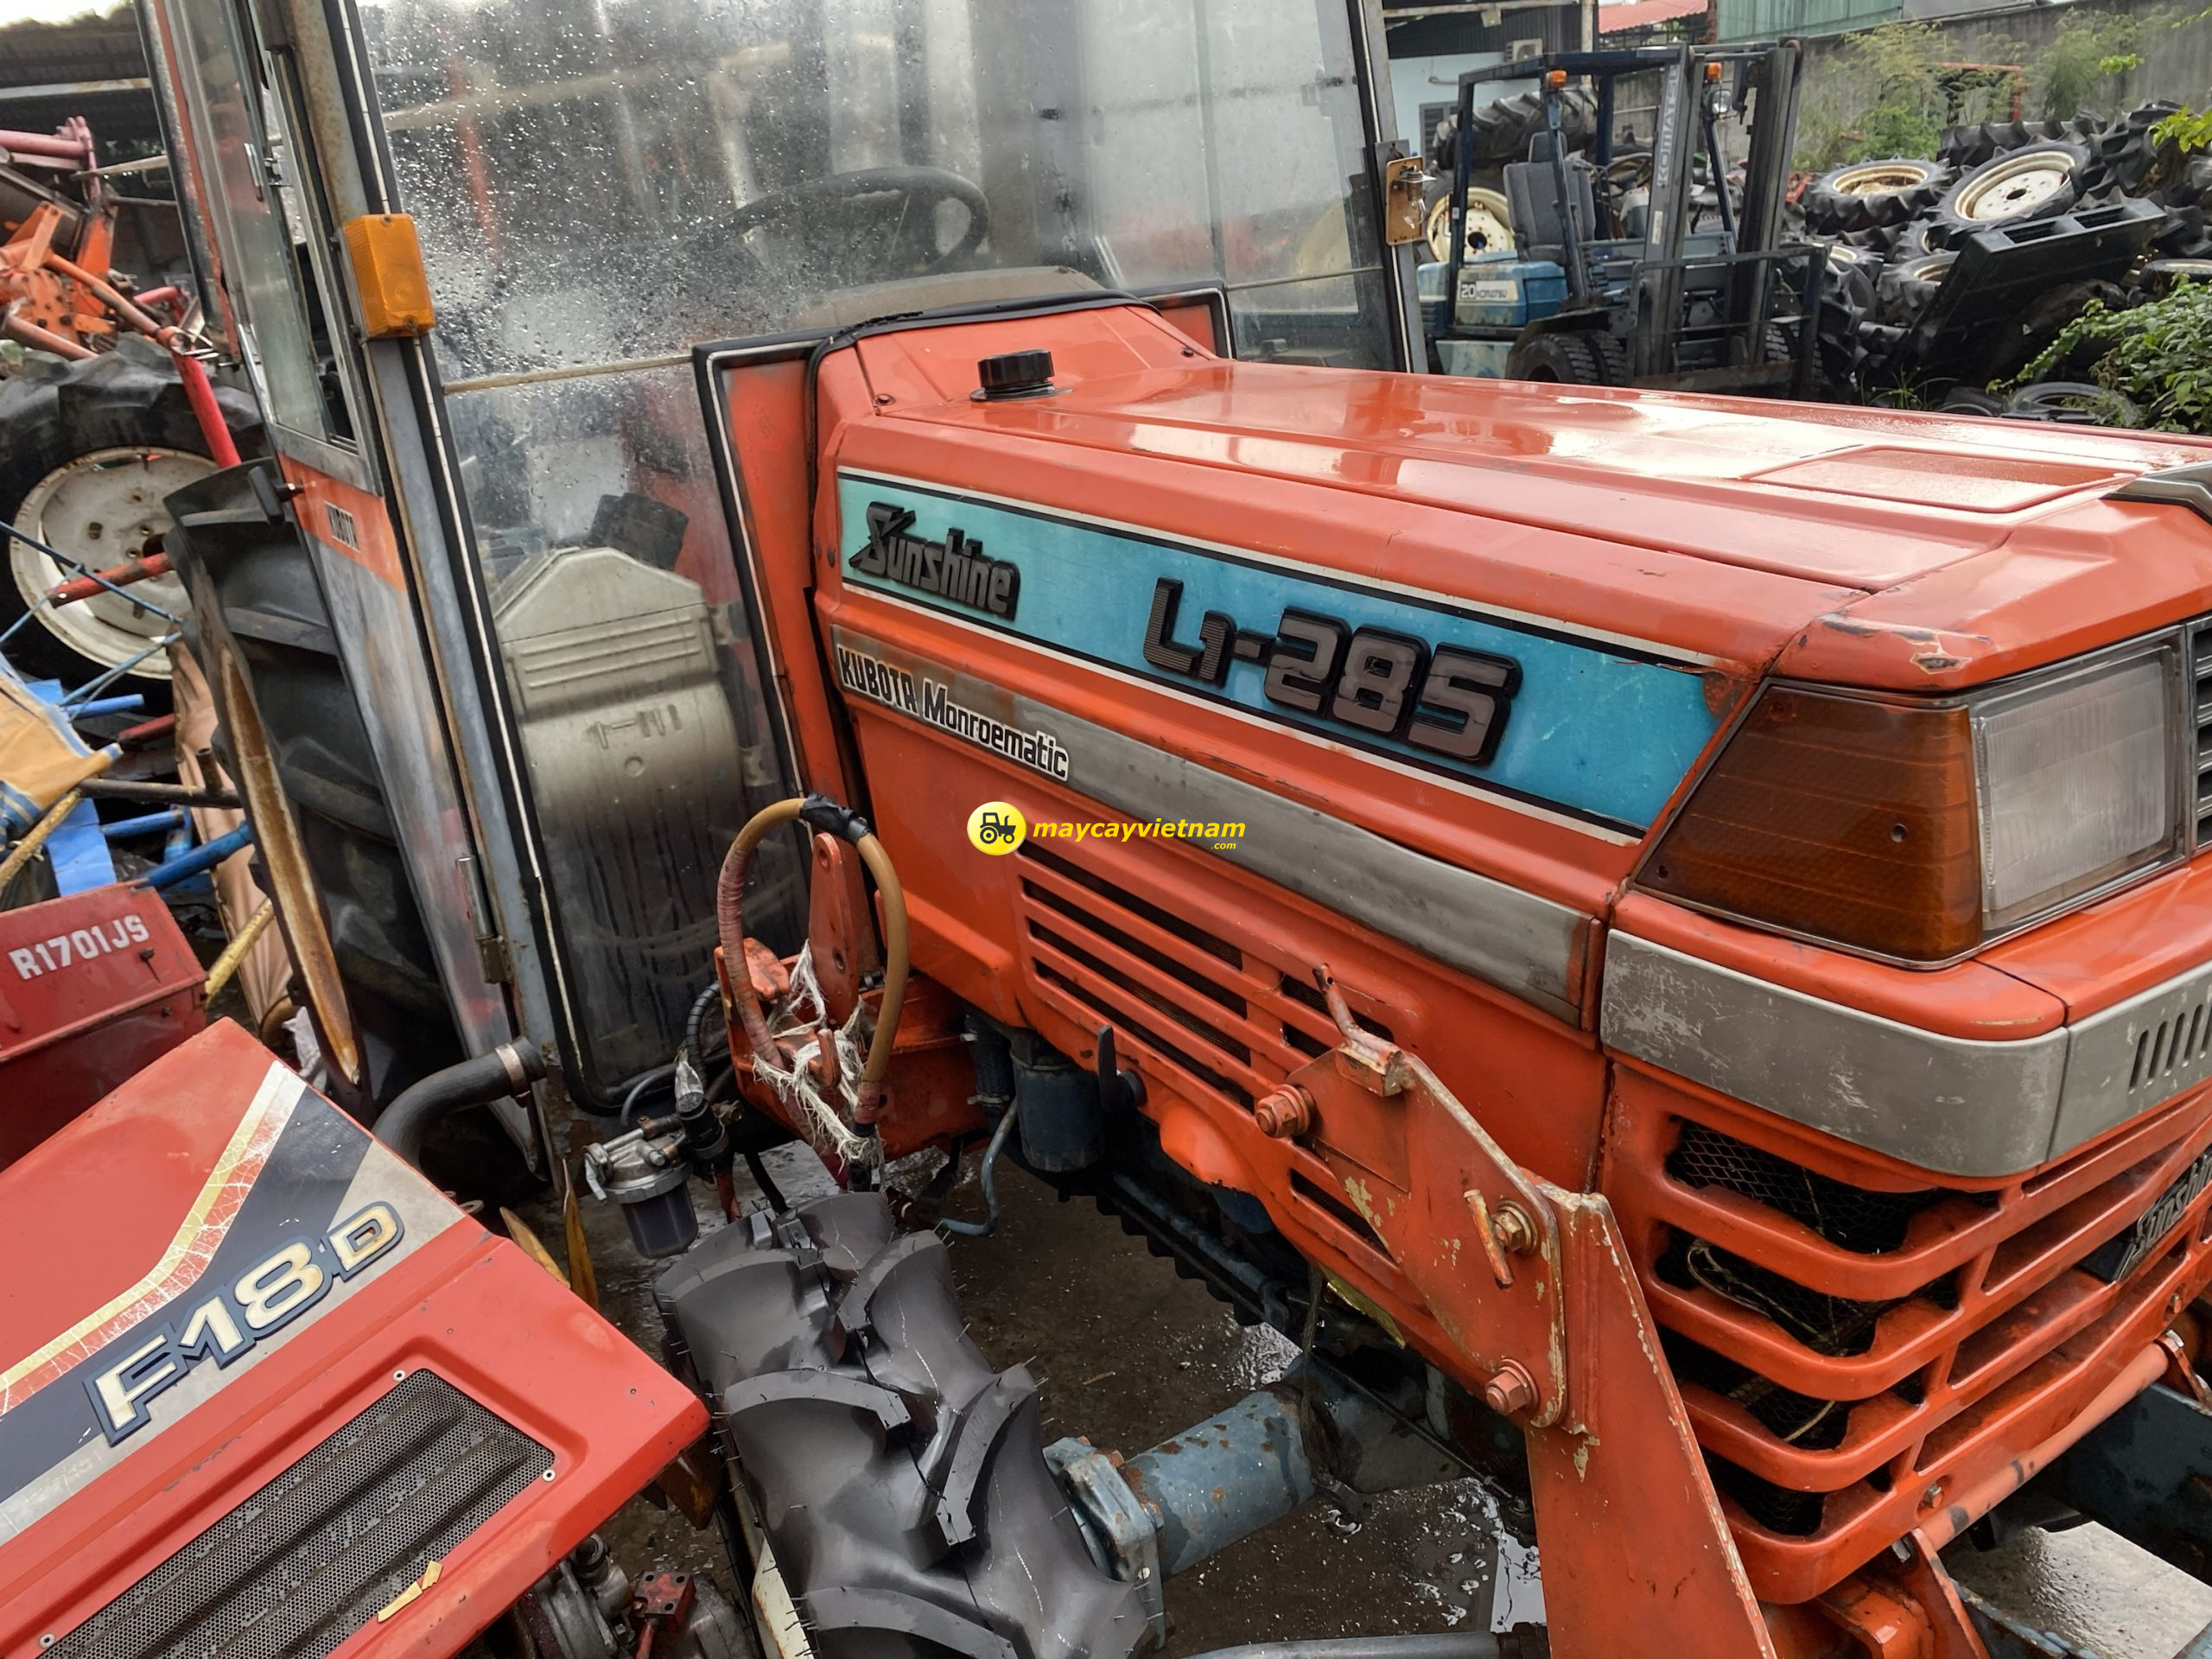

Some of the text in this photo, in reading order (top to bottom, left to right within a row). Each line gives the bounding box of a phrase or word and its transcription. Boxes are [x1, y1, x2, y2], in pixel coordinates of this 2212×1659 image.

[1657, 64, 1681, 186] KOMATSU
[1460, 283, 1477, 299] 20
[849, 501, 1020, 621] Sunshine
[838, 645, 1068, 779] KUBOTA Monroematic
[1142, 576, 1523, 767] L1-285
[8, 914, 149, 981] R1701JS
